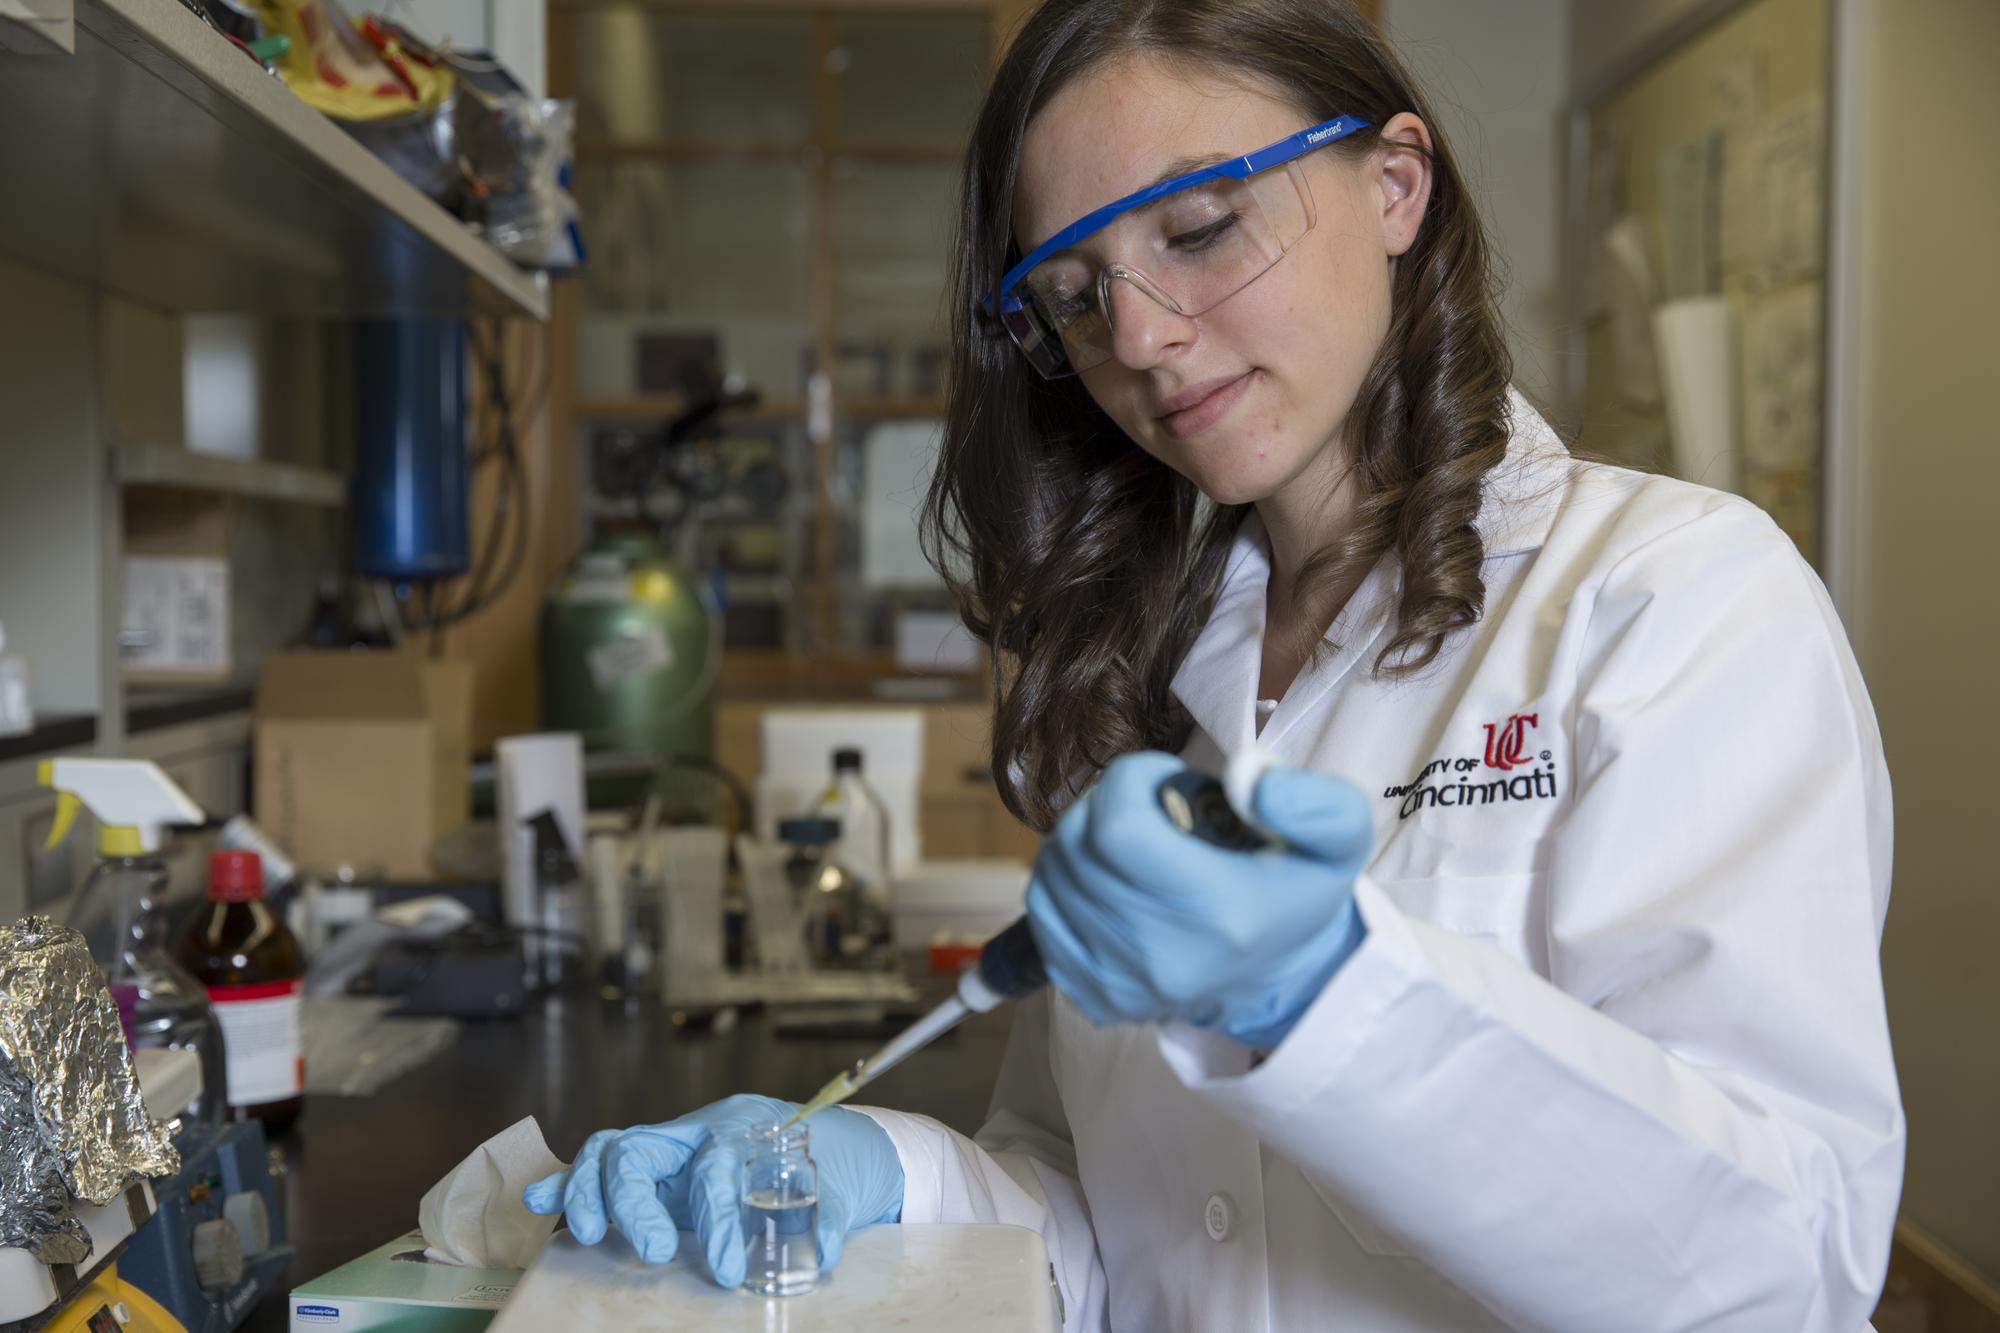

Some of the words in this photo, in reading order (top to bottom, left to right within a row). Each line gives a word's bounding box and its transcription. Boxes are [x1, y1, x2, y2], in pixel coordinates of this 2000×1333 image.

[1454, 758, 1480, 772] OF
[1483, 713, 1538, 770] UC
[1400, 762, 1557, 819] Cincinnati
